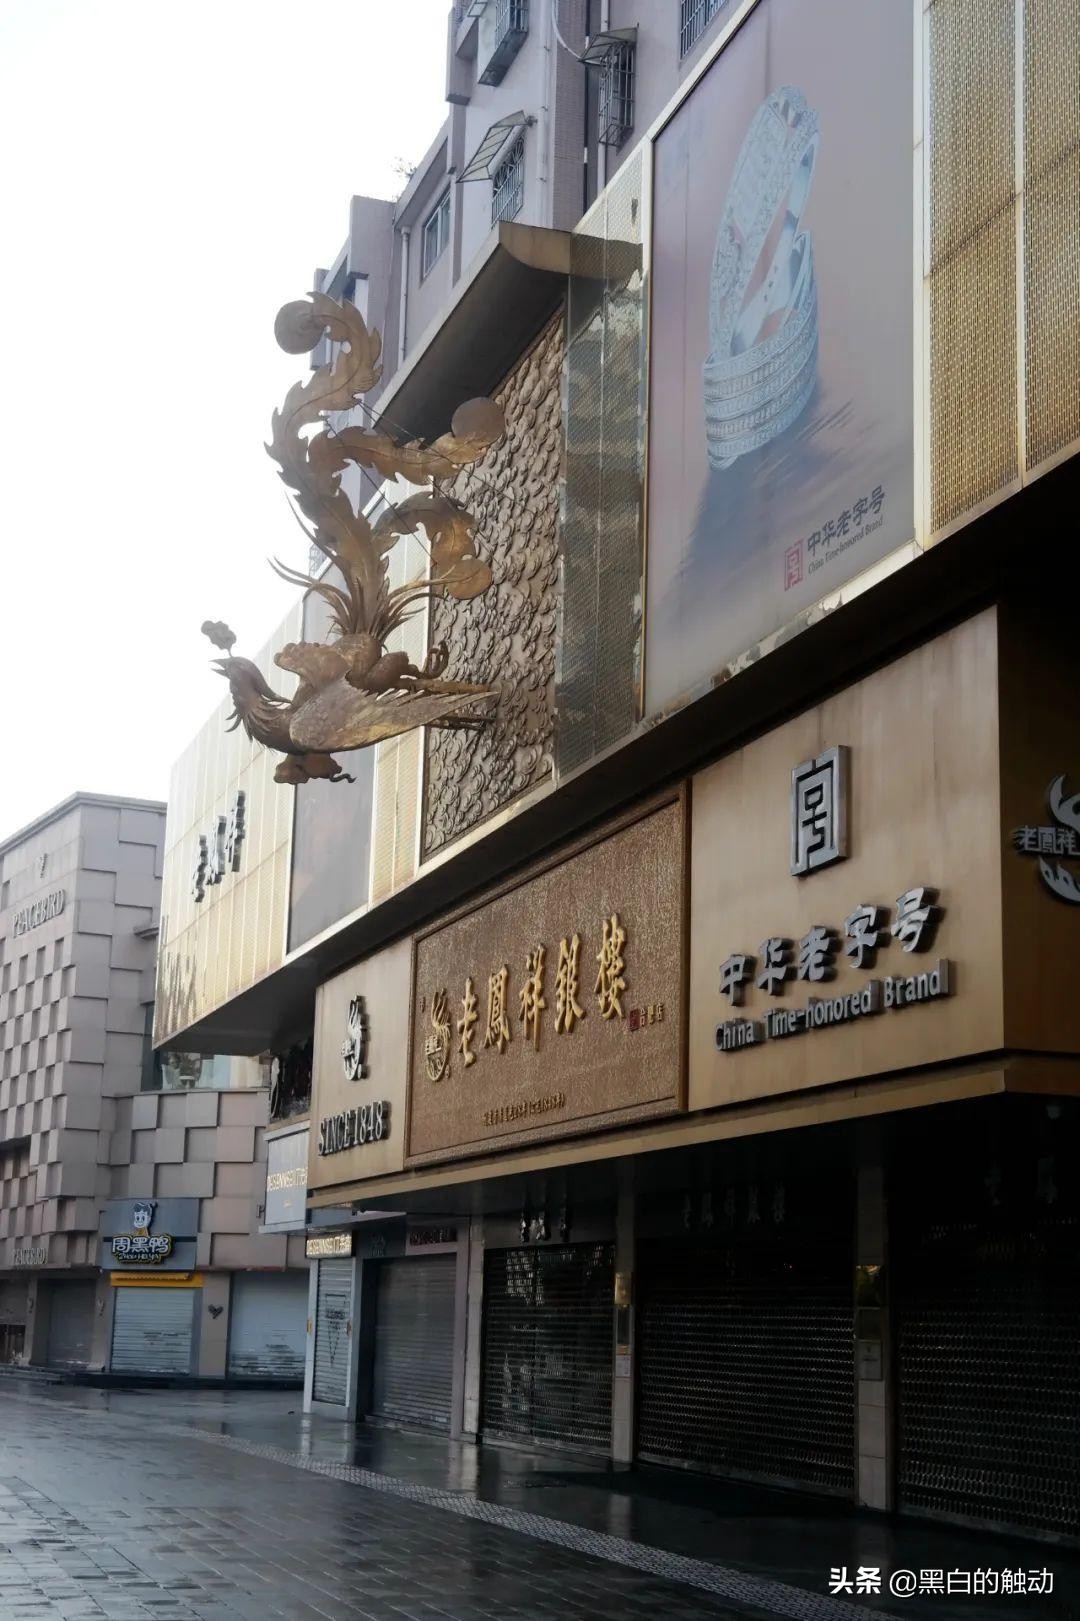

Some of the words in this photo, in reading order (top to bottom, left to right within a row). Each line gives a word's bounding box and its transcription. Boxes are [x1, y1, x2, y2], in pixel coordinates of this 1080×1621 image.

[807, 485, 885, 556] 中华老字号
[13, 889, 66, 938] PEACEBIRD
[719, 887, 943, 1005] 中华老字号
[456, 913, 628, 1068] 老鳳祥銀樓
[715, 1018, 757, 1051] China
[763, 981, 879, 1041] Time-honored
[883, 958, 951, 1009] Brand
[318, 1108, 352, 1156] SINCE
[353, 1100, 388, 1146] 1848
[112, 1236, 169, 1254] 周黑鸭
